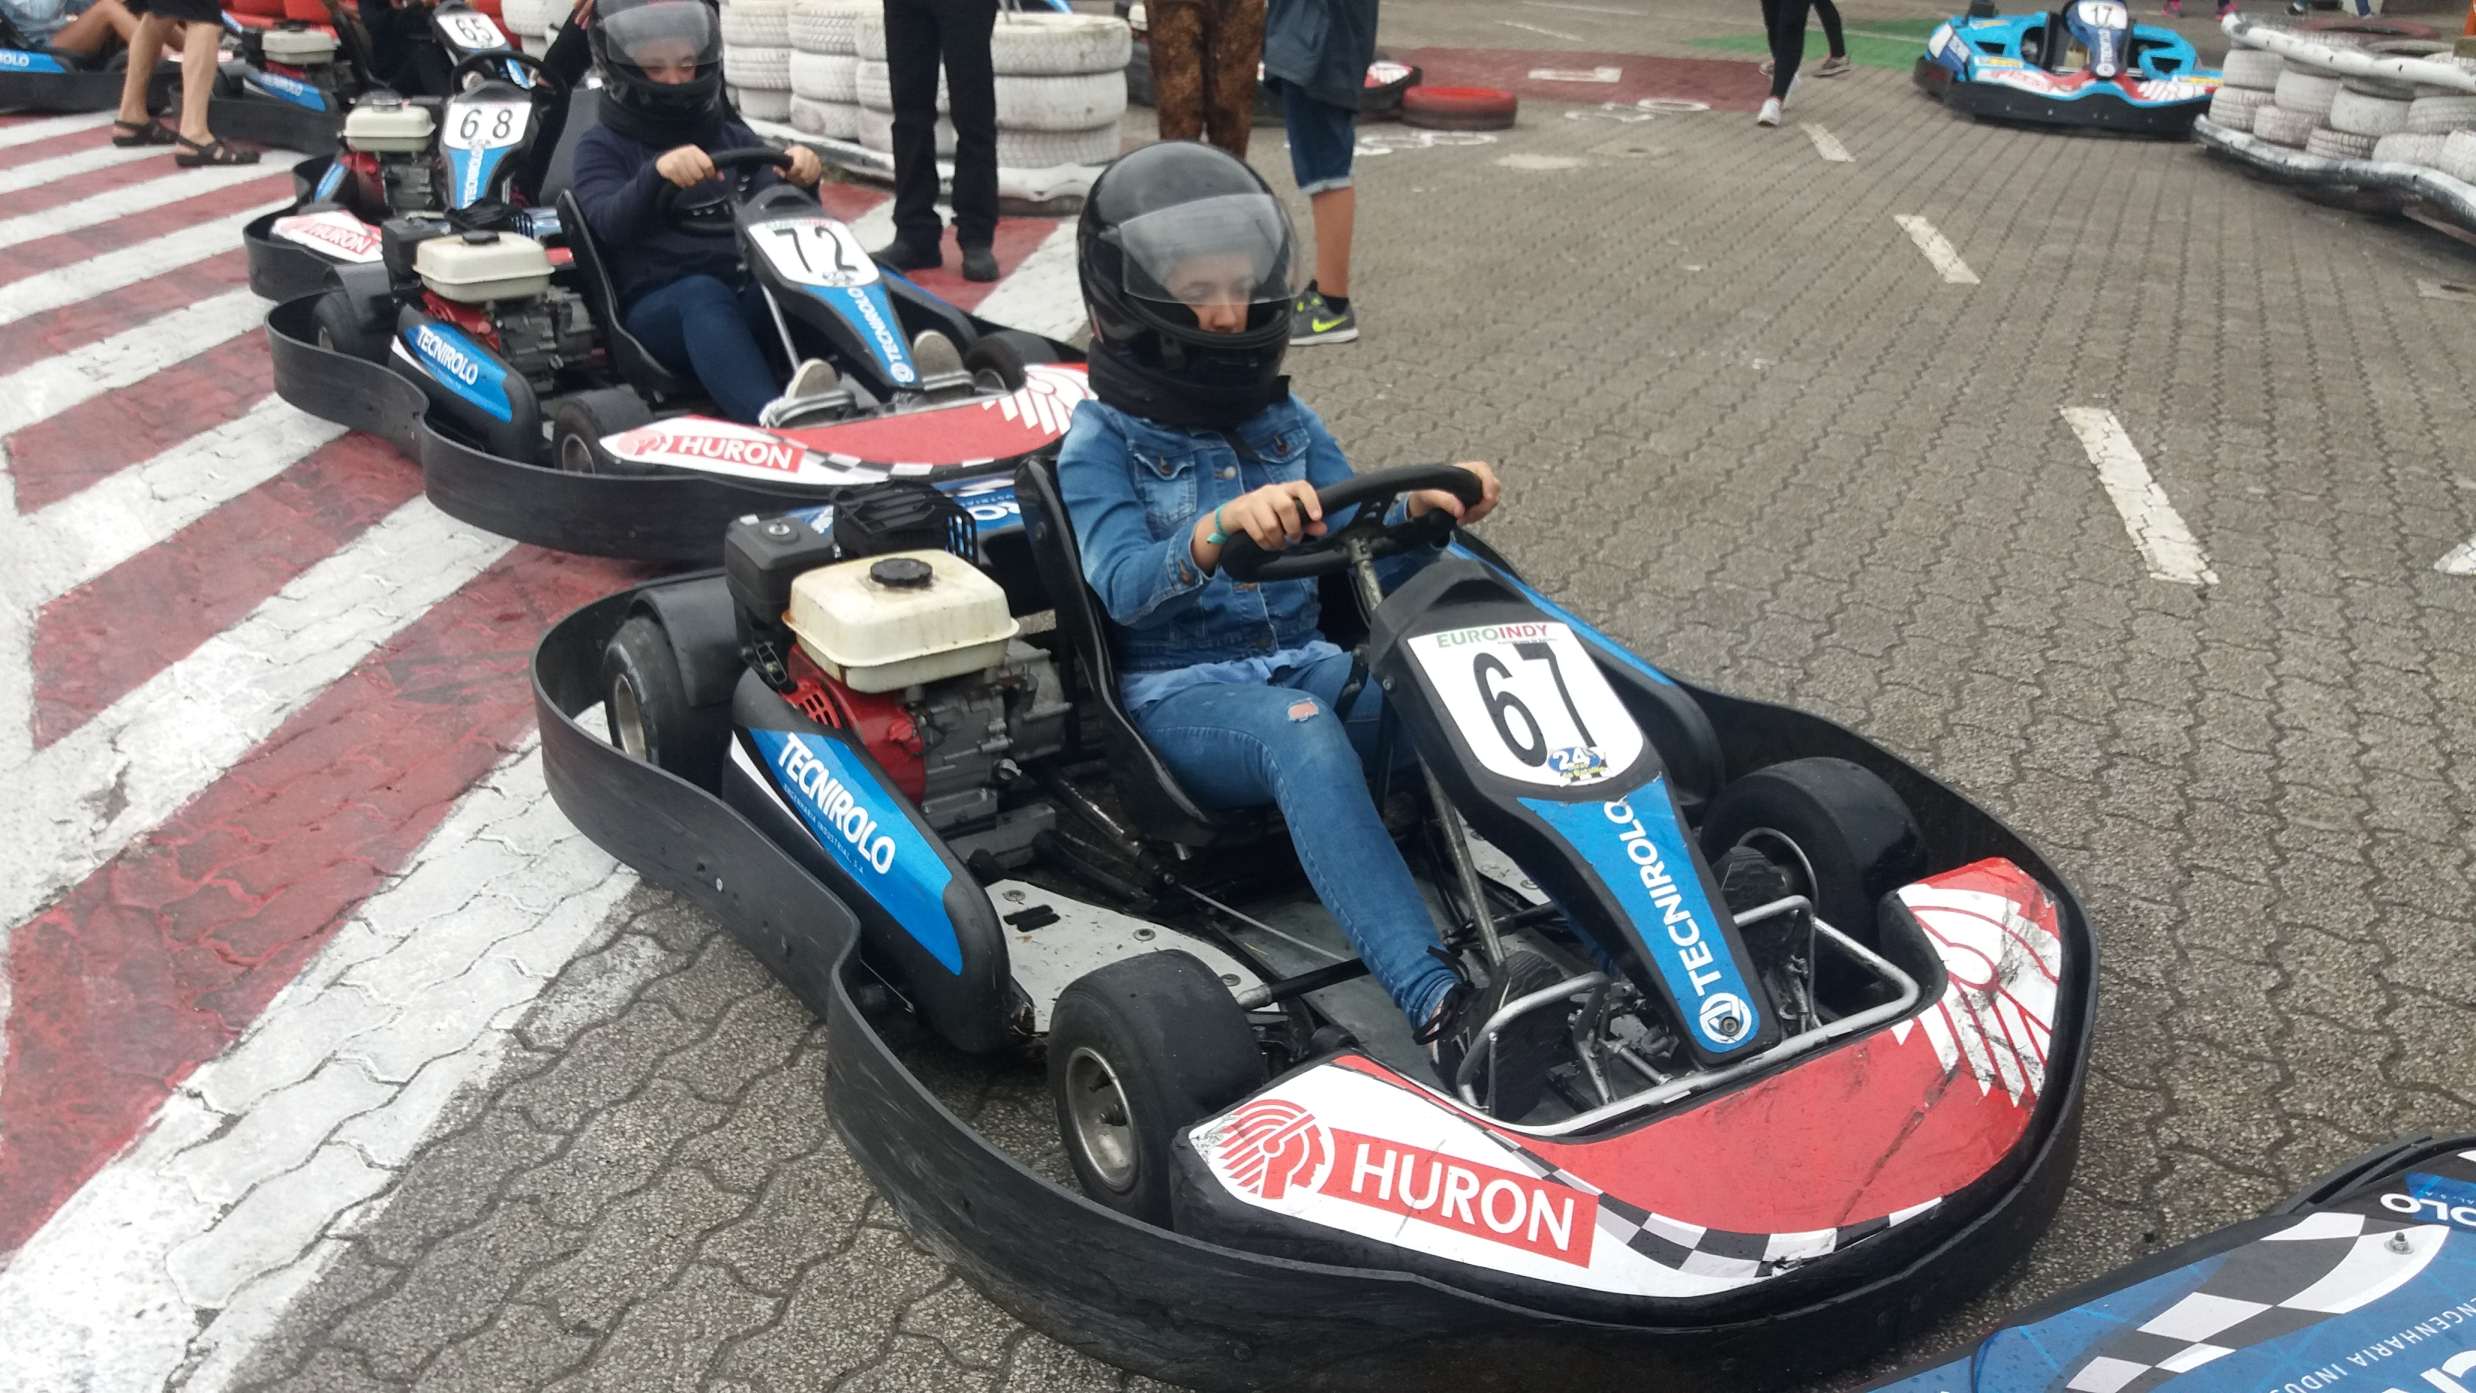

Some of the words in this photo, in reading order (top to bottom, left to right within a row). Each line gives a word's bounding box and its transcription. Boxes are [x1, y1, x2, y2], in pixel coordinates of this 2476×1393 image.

[456, 17, 493, 41] 65
[460, 108, 514, 140] 68
[772, 225, 859, 274] 72
[416, 324, 479, 386] TECNIROLO
[678, 435, 794, 471] HURON
[1436, 624, 1548, 648] EUROINDY
[1473, 641, 1597, 768] 67
[778, 731, 896, 875] TECNIROLO
[1603, 795, 1722, 997] TECNIROLO
[1350, 1143, 1576, 1252] HURON
